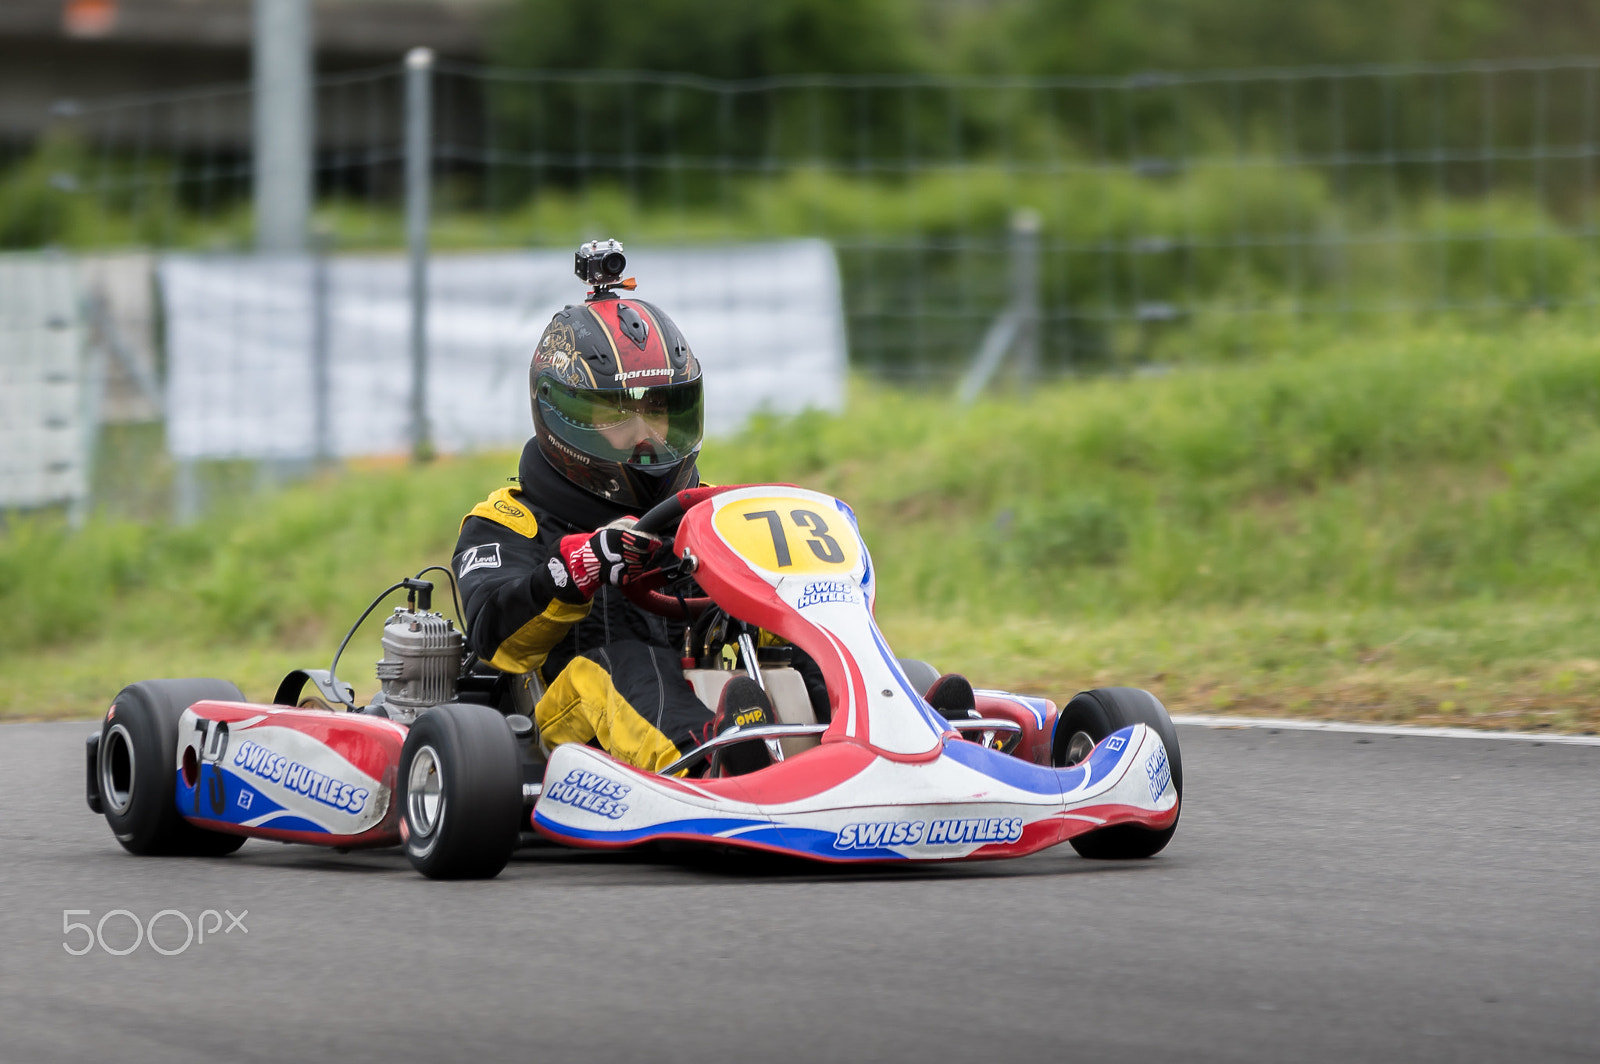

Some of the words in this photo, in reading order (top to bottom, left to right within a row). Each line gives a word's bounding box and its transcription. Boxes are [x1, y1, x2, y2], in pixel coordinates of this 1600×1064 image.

[743, 510, 845, 567] 73
[804, 581, 852, 596] SWISS
[736, 709, 763, 726] OMP
[234, 741, 286, 784] SWISS
[284, 762, 369, 815] HUTLESS
[564, 769, 631, 801] SWISS
[546, 782, 629, 820] HUTLESS
[834, 821, 924, 850] SWISS
[926, 817, 1024, 845] HUTLESS
